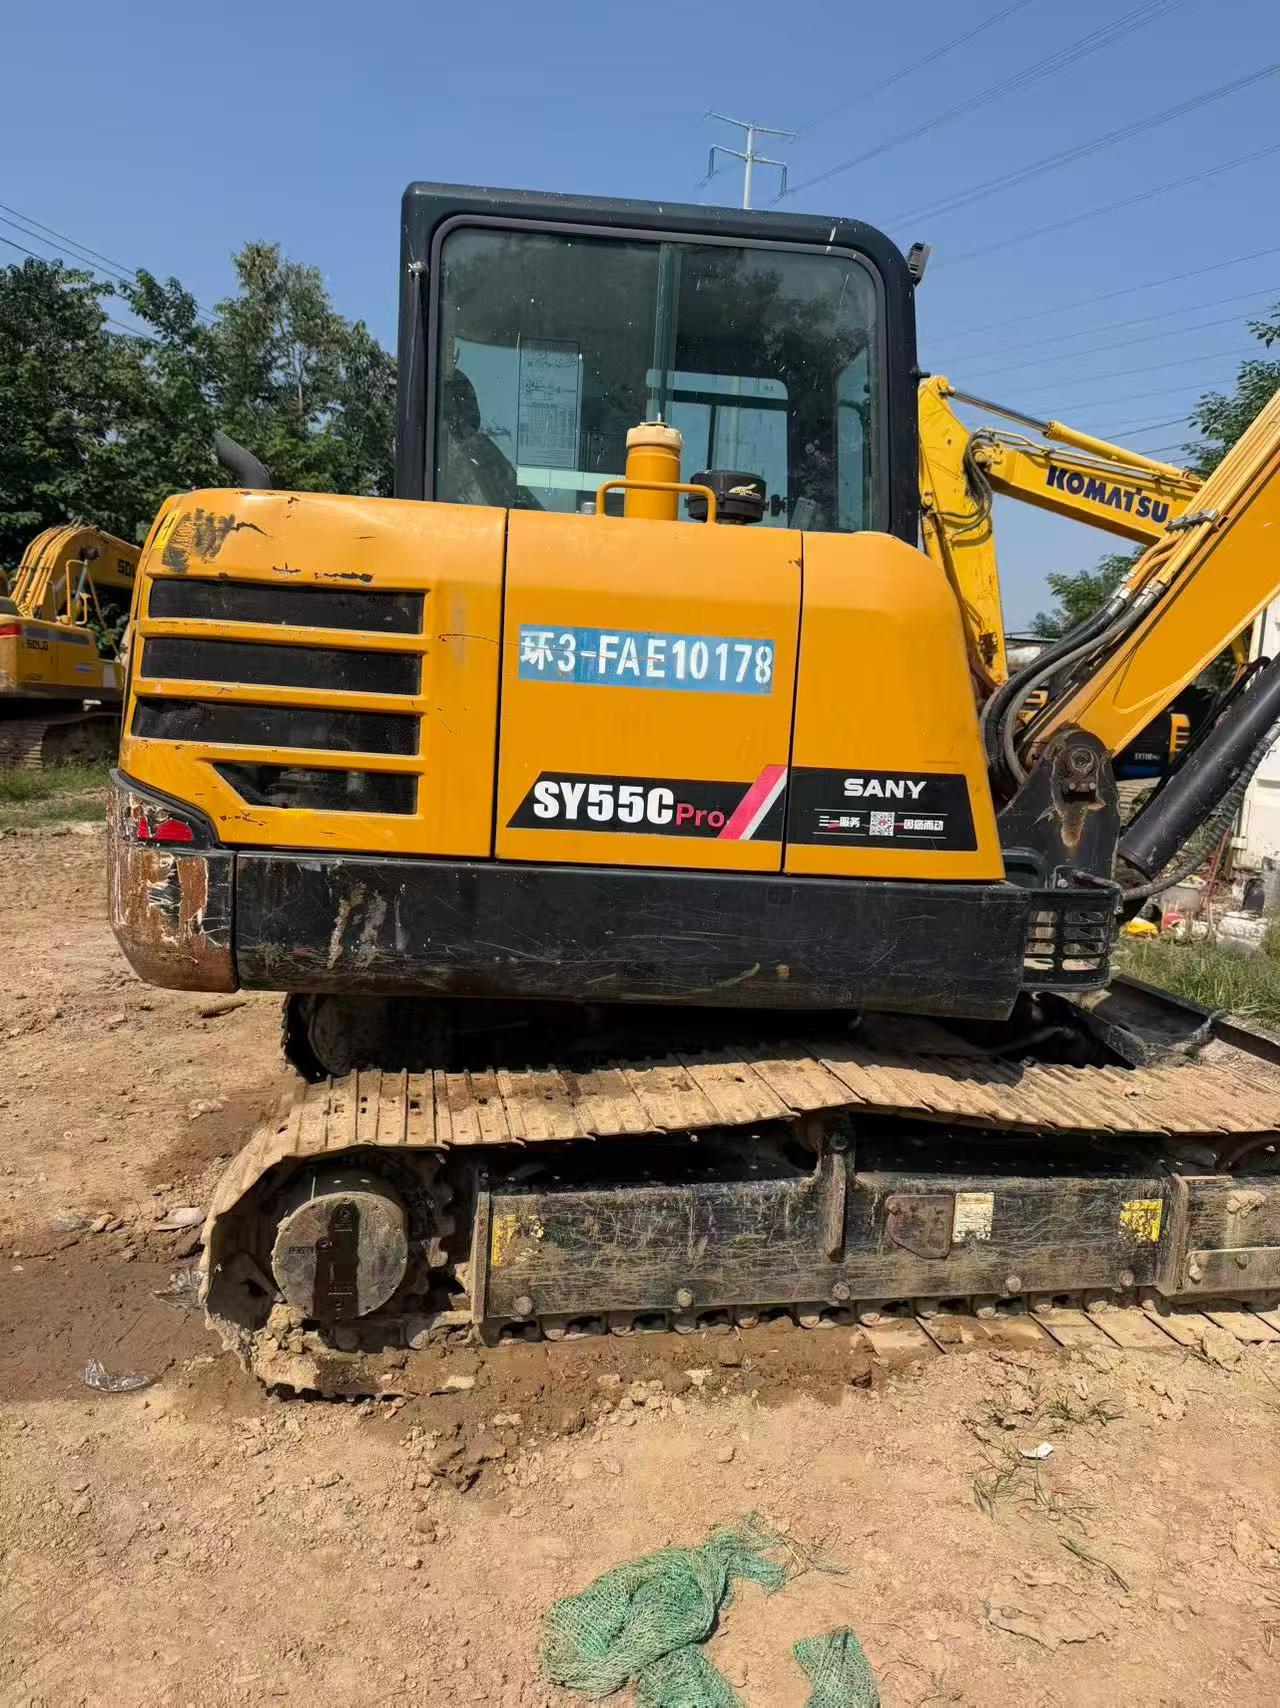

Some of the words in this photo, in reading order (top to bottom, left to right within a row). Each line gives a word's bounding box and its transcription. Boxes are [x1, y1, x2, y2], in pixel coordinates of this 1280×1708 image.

[1046, 465, 1169, 523] KOMATSU
[520, 630, 773, 684] 环3-FAE10178
[533, 781, 674, 825] SY55C
[675, 802, 725, 828] Pro
[844, 778, 927, 799] SANY
